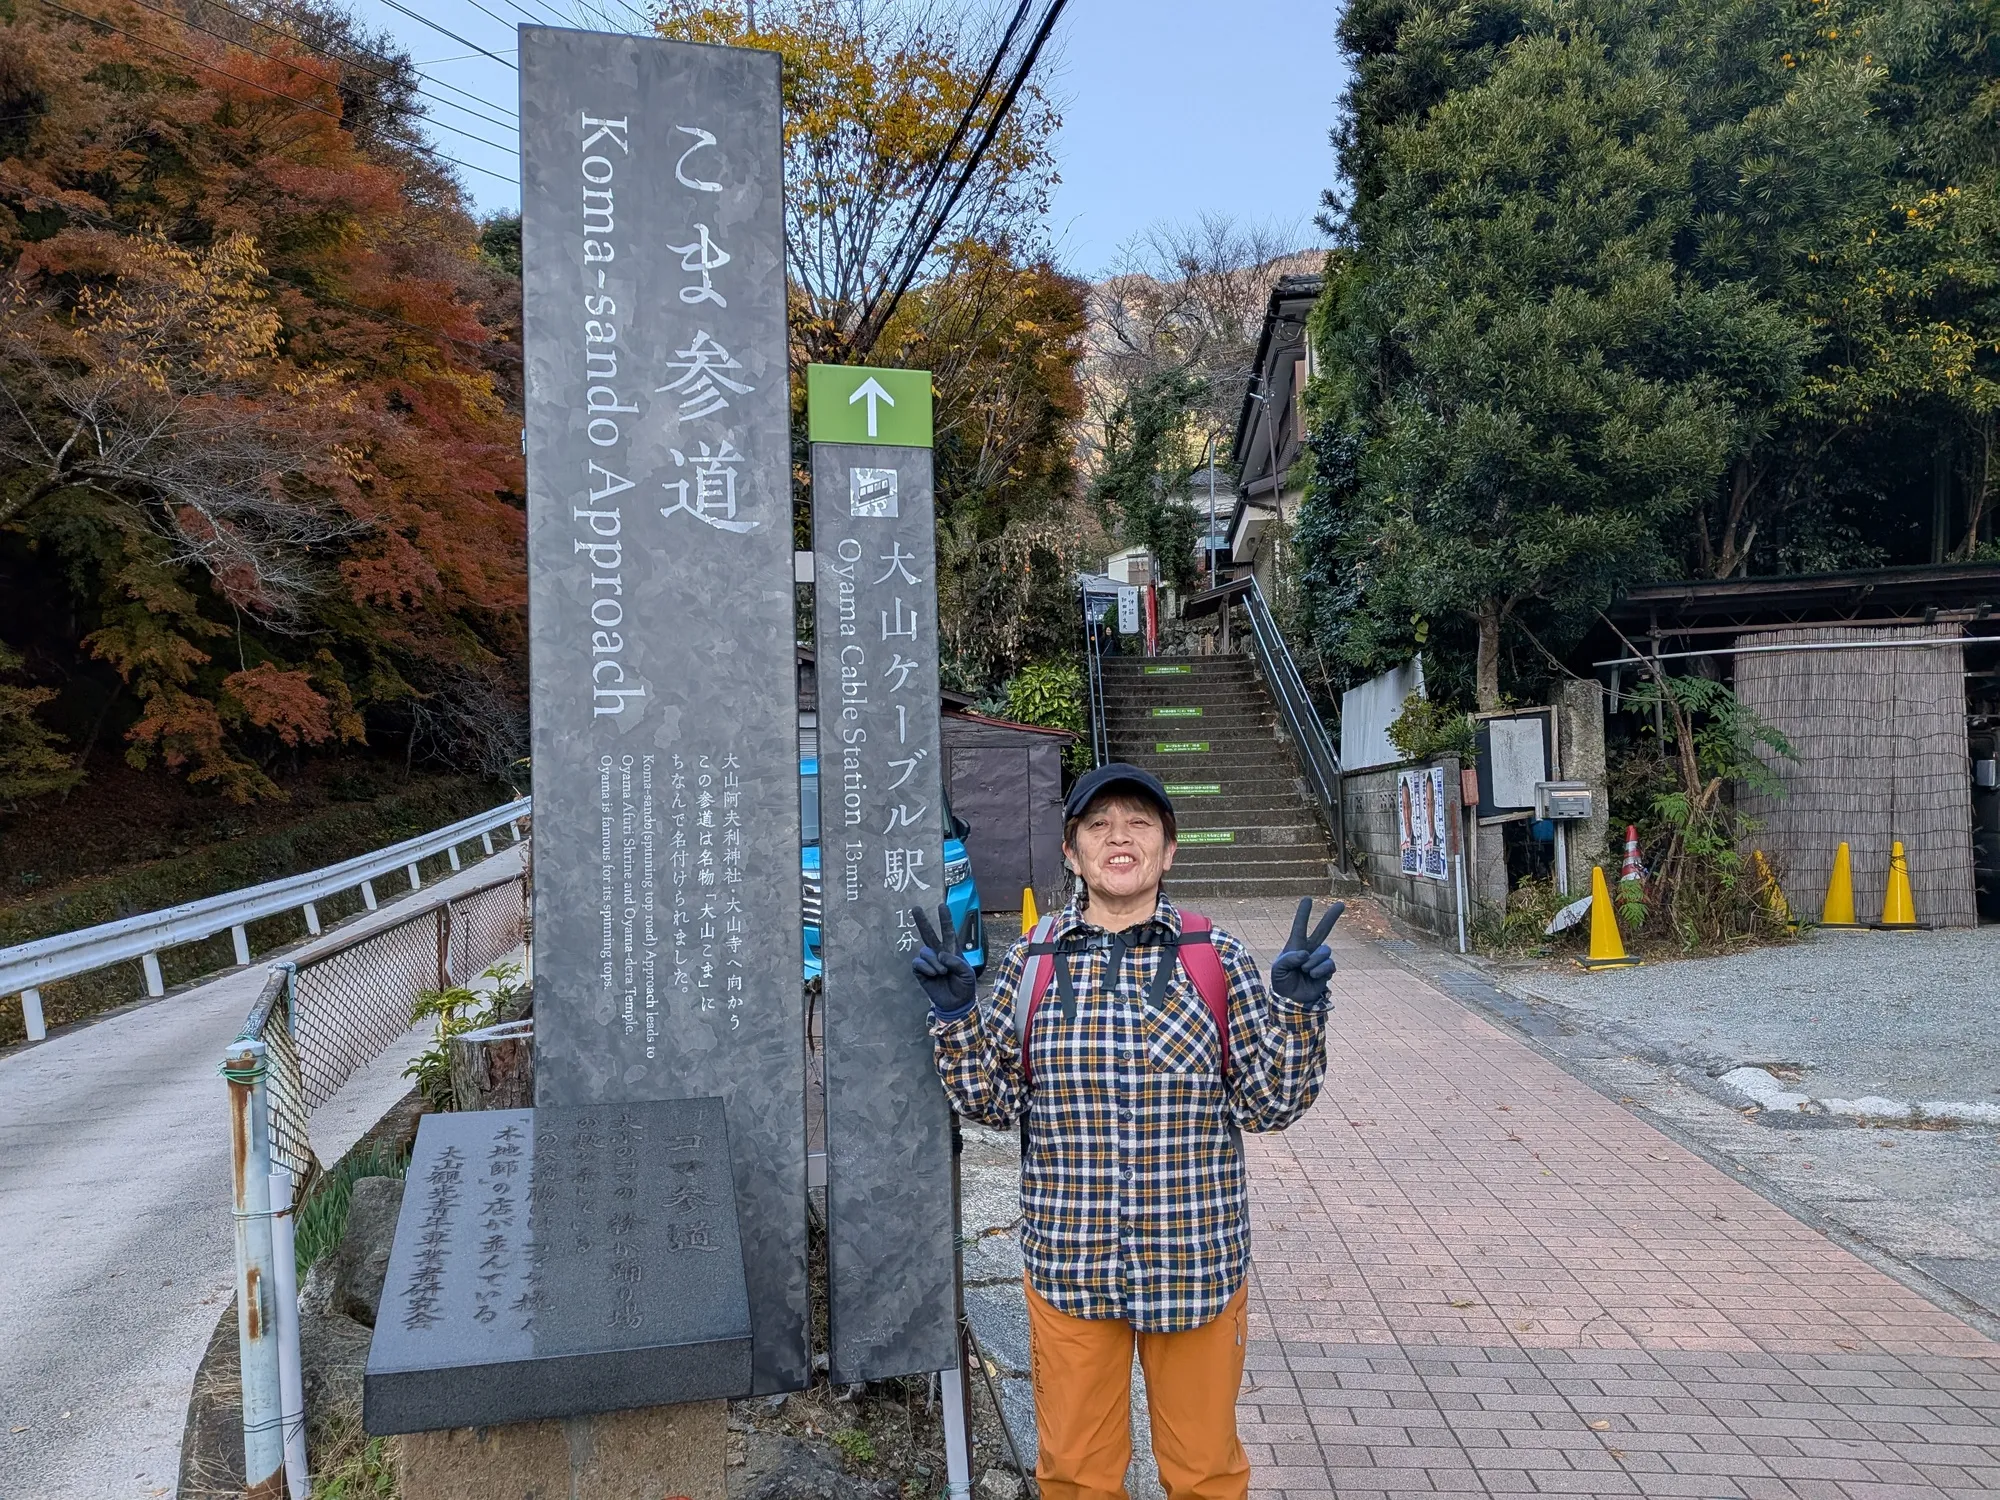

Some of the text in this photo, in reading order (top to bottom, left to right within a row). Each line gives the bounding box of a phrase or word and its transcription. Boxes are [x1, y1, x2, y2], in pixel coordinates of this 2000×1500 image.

[655, 125, 760, 533] こま参道
[573, 112, 646, 719] Koma-sando Approach
[832, 538, 862, 637] Oyama
[841, 645, 868, 720] Cable
[873, 541, 931, 893] 大山ケーブル駅
[842, 728, 867, 827] Station
[598, 754, 615, 990] Oyama is famous for its spinning tops.
[619, 754, 639, 1036] Oyama Afuri Shrine and Oyama-dera Temple.
[641, 891, 654, 912] top
[642, 914, 658, 947] road)
[670, 753, 690, 993] ちなんで名付けられました。
[695, 754, 717, 1012] この参道は名物「大山こま」に
[721, 752, 744, 1031] 大山阿夫利神社・大山寺へ向かう
[642, 950, 659, 1009] Approach
[646, 1012, 659, 1043] leads
[646, 1046, 657, 1059] to
